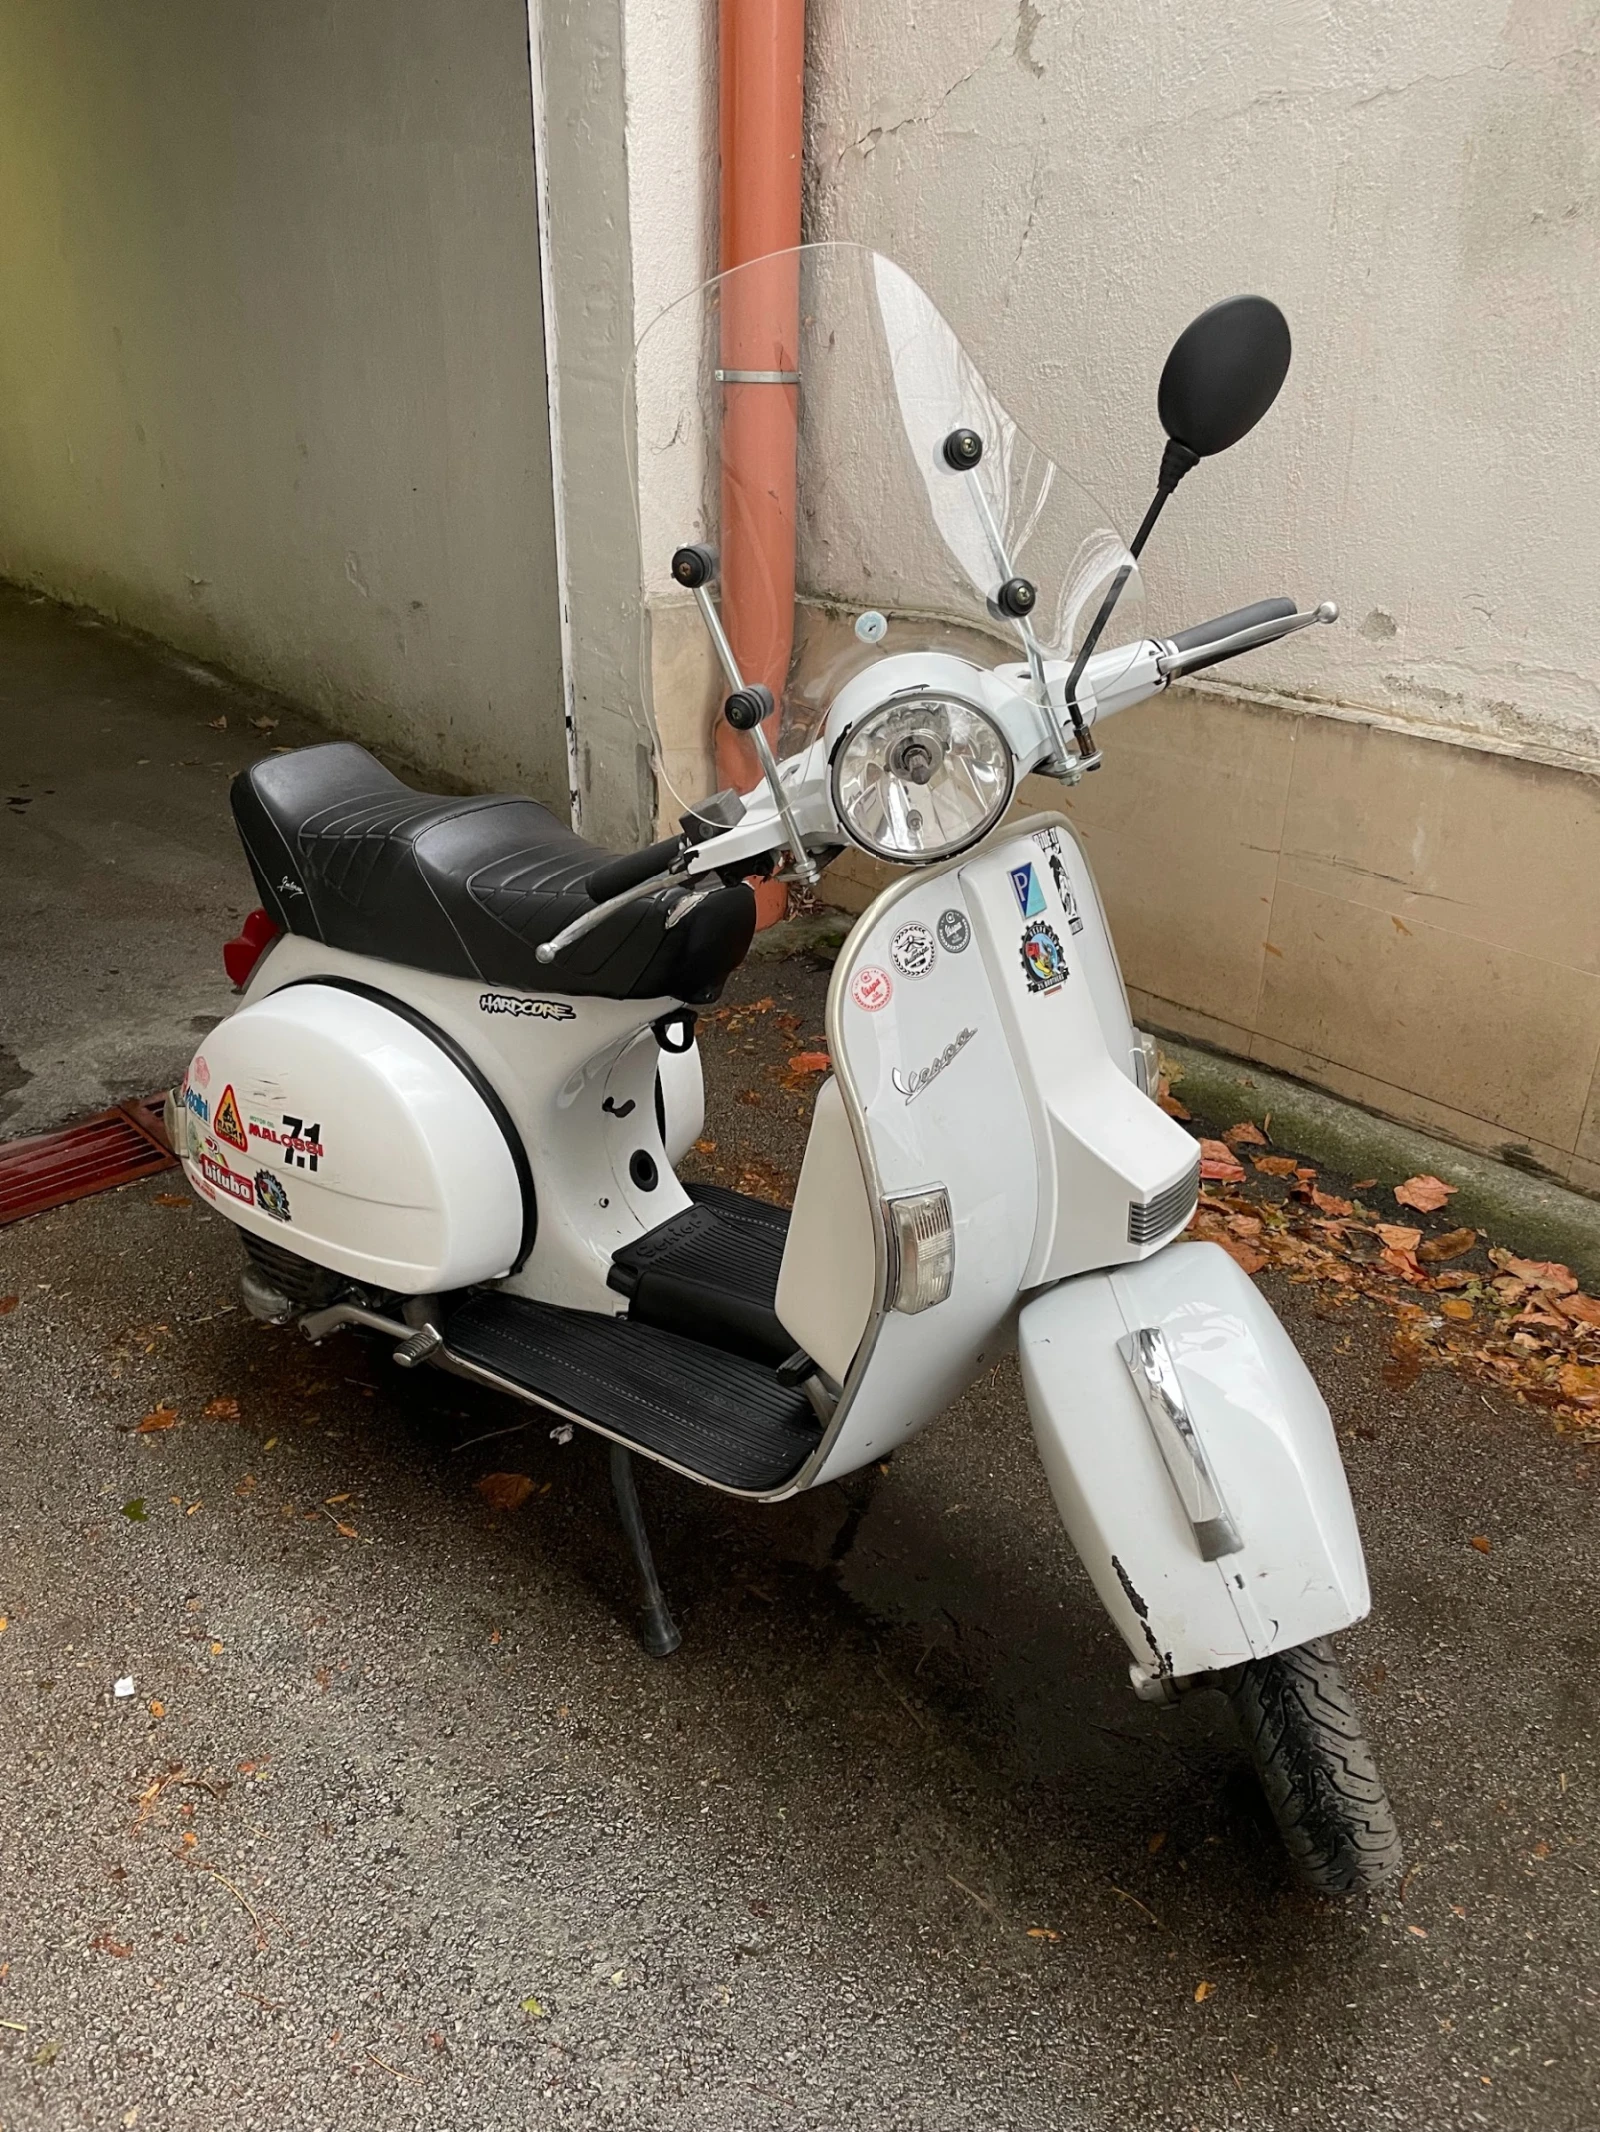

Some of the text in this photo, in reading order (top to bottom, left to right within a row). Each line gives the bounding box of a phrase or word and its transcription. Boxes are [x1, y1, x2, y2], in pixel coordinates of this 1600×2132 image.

[1012, 871, 1029, 902] P
[861, 978, 881, 998] Vespa
[480, 993, 576, 1021] HARDCORE
[892, 1027, 978, 1106] Vespa
[249, 1122, 323, 1157] MALOSSI
[204, 1159, 251, 1199] bitubo
